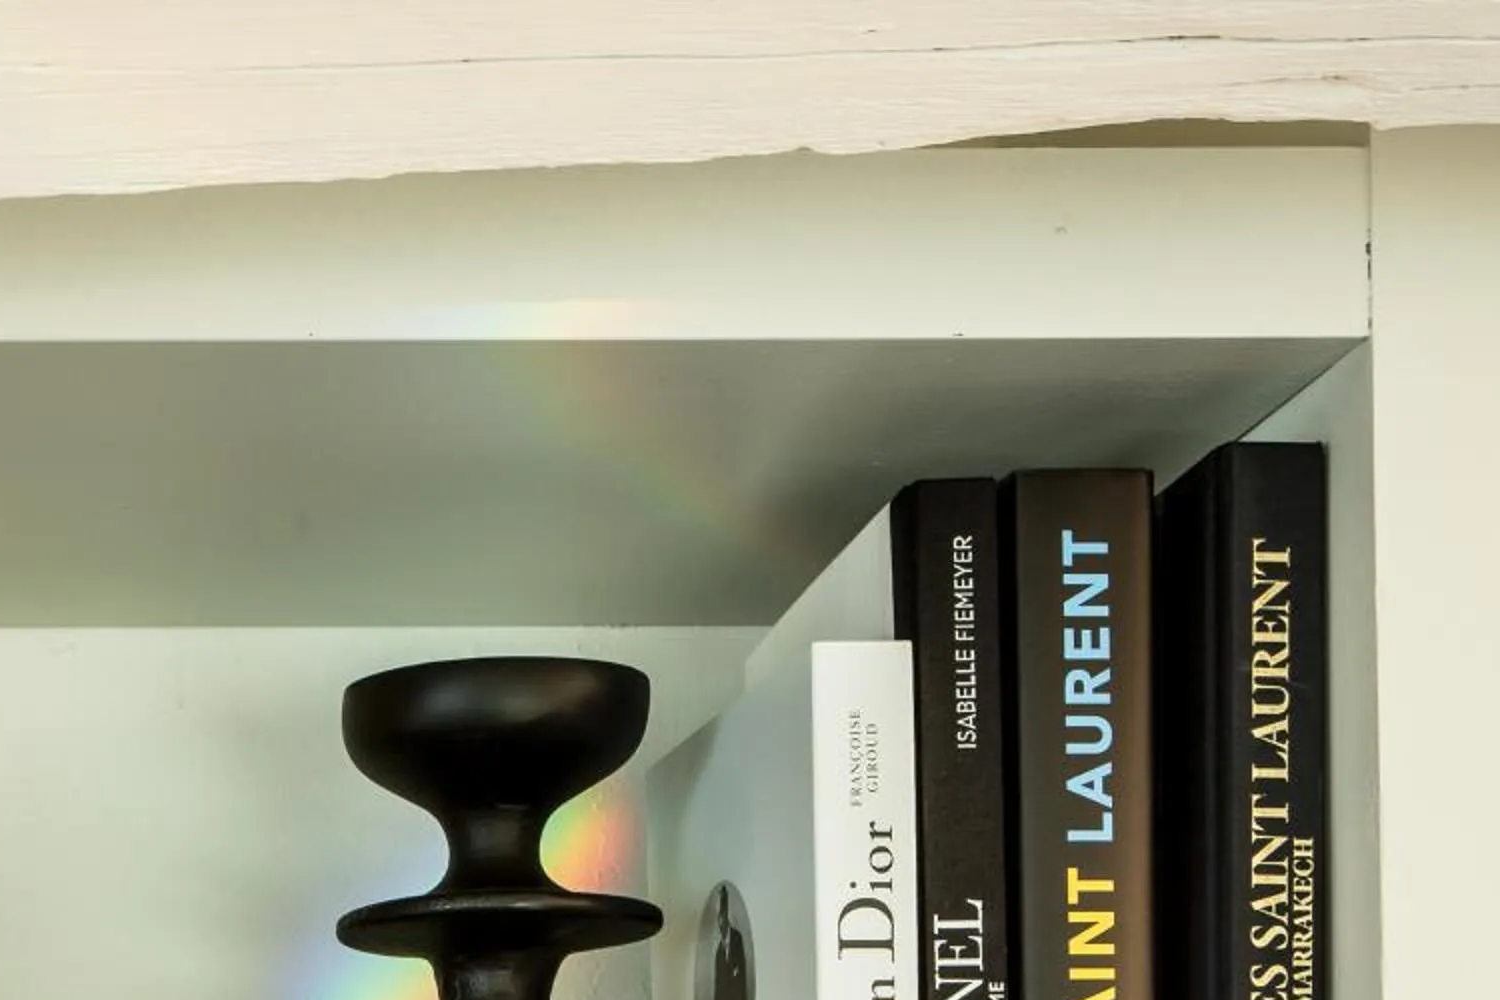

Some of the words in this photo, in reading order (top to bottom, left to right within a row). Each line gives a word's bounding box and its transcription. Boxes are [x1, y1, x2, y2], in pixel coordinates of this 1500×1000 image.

[953, 535, 976, 642] FIEMEYER
[955, 649, 977, 750] ISABELLE
[1061, 529, 1114, 843] LAURENT
[1251, 537, 1291, 784] LAURENT
[866, 722, 879, 794] GIROUD
[837, 820, 896, 963] Dior
[1250, 793, 1290, 952] SAINT
